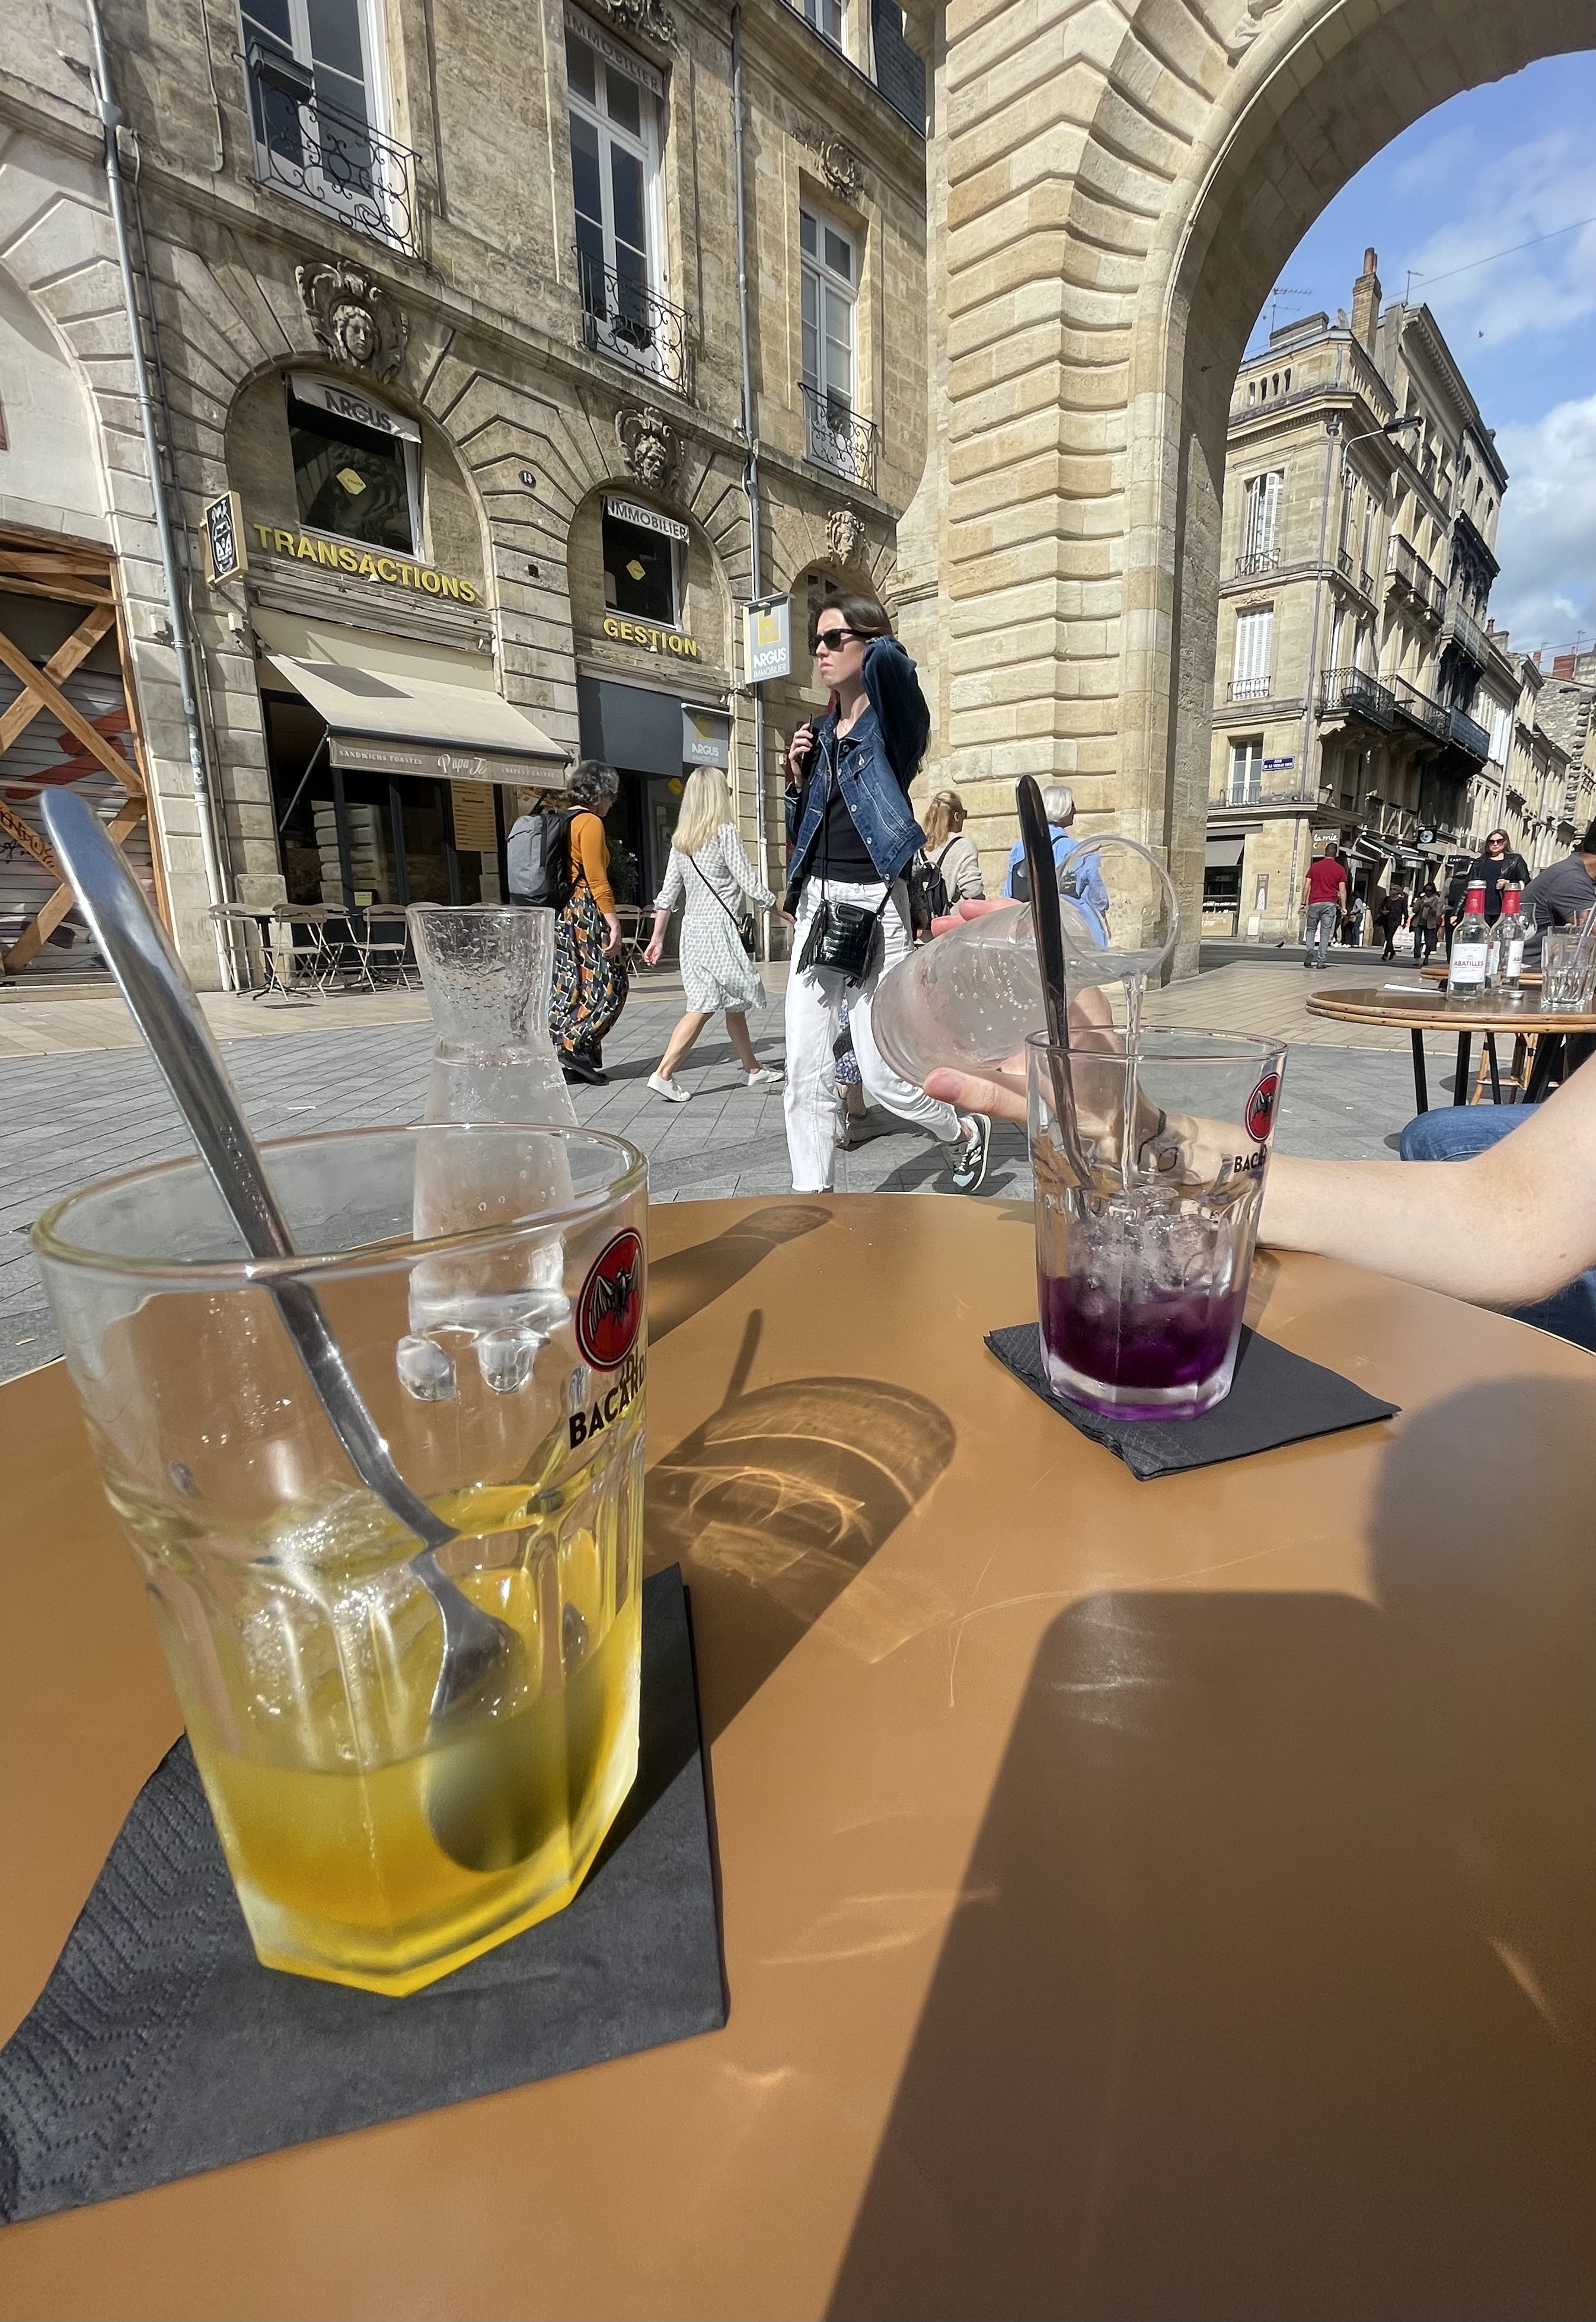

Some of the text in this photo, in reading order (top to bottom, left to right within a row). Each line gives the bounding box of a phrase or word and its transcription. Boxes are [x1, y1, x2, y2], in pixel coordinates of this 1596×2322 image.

[324, 389, 391, 430] ARGUS
[523, 472, 533, 484] 14
[611, 500, 687, 539] IMMOBILIER
[253, 523, 475, 602] TRANSACTIONS
[603, 618, 697, 656] GESTION
[753, 647, 787, 669] ARGUS
[754, 663, 787, 679] IMMOBILIER
[692, 742, 719, 756] ARGUS
[339, 750, 387, 761] SANDWICHS
[438, 753, 469, 774] Papa
[1322, 833, 1338, 841] mie
